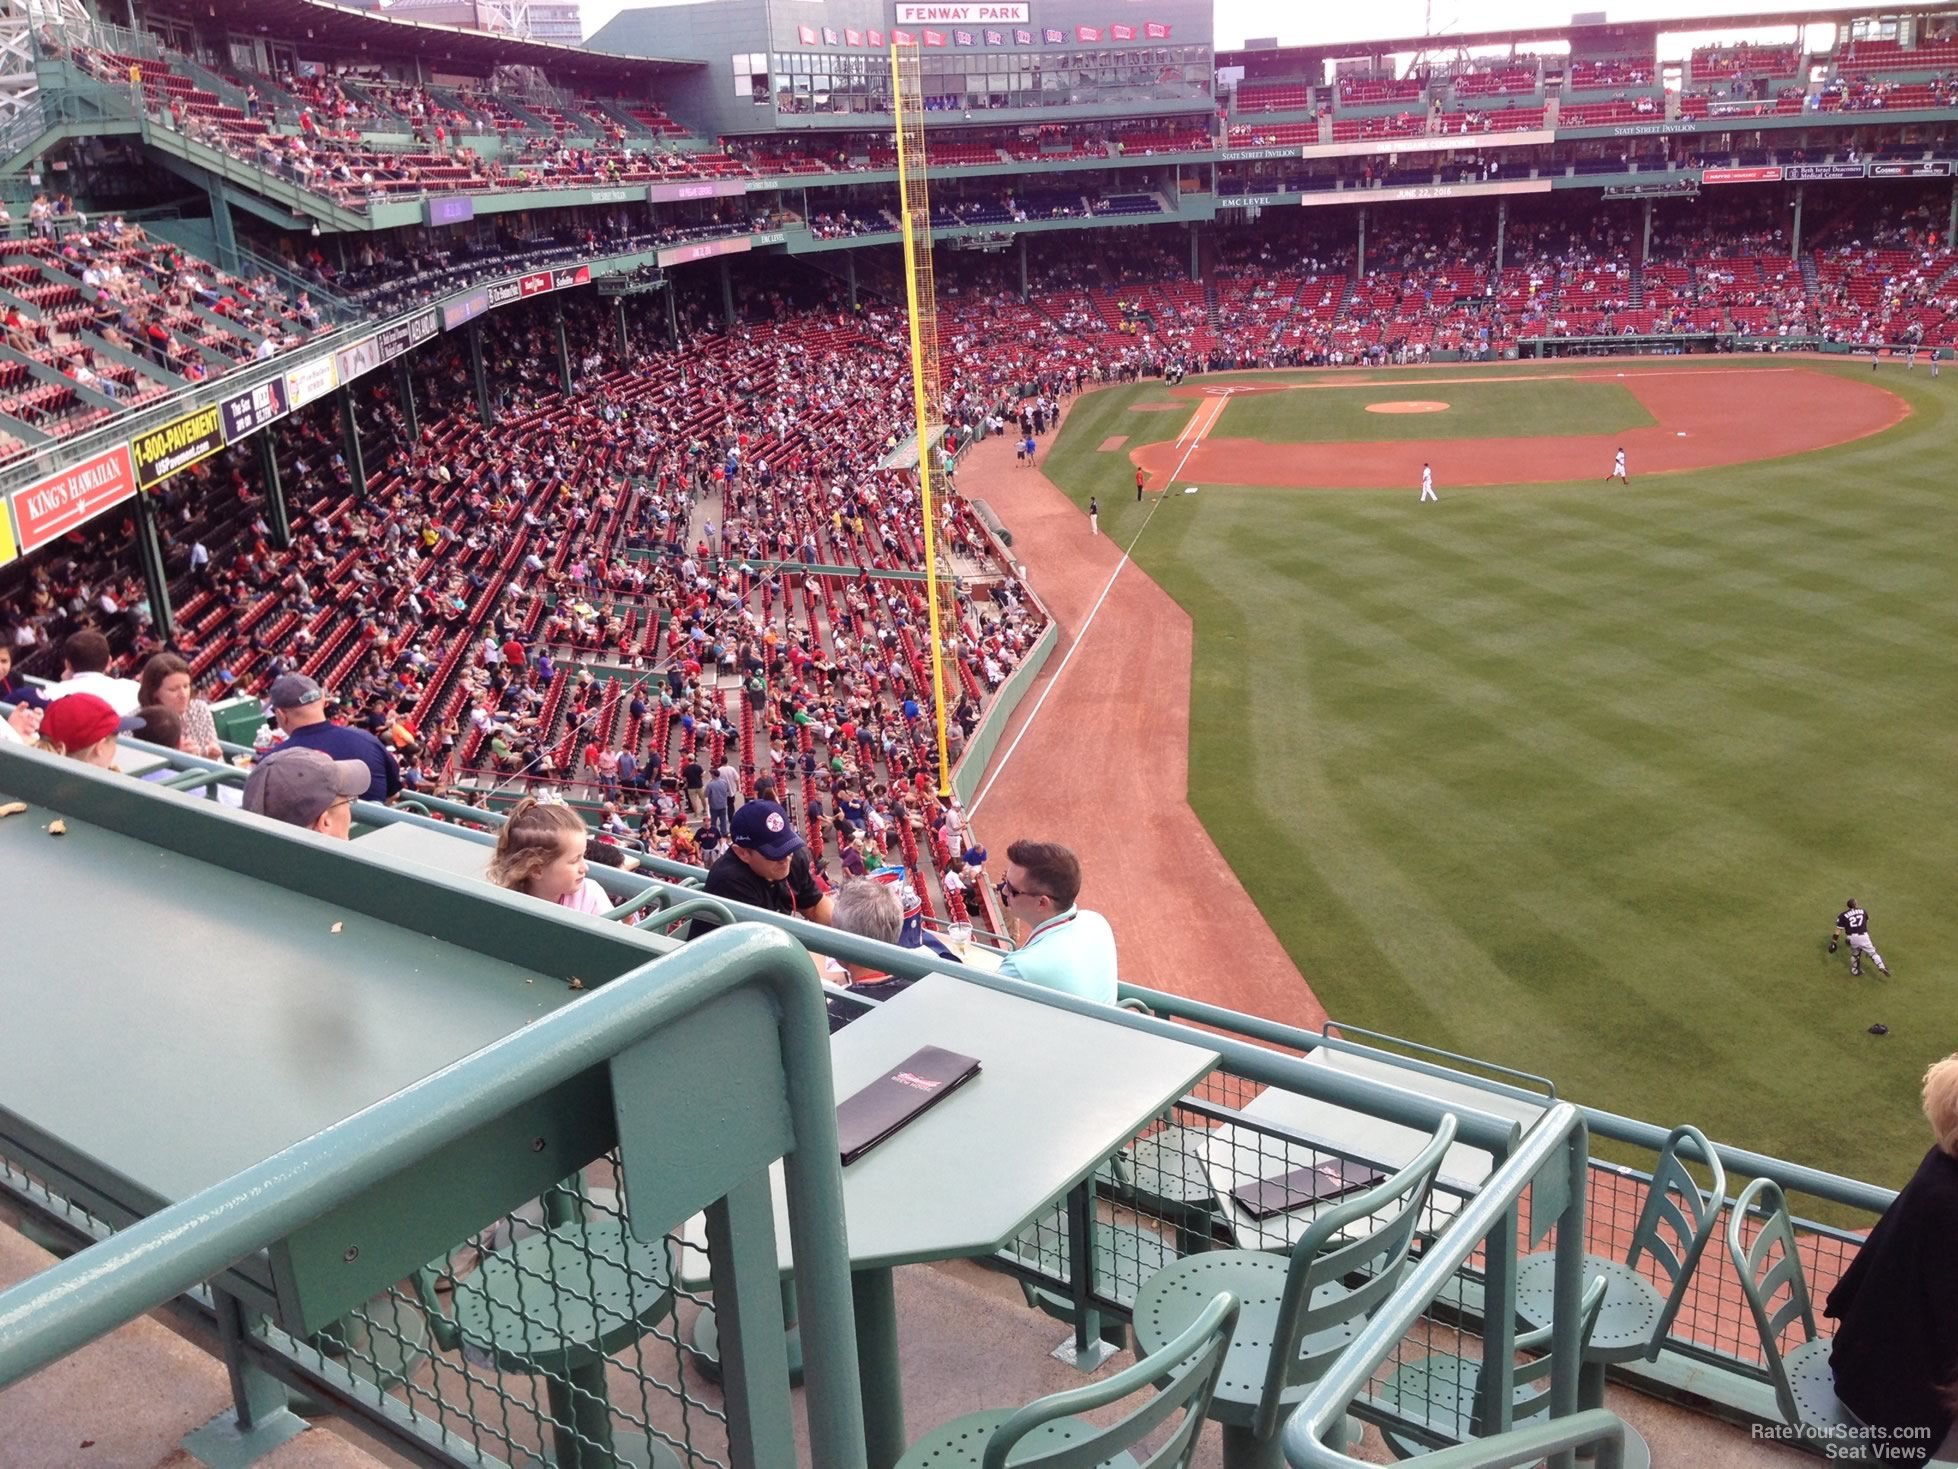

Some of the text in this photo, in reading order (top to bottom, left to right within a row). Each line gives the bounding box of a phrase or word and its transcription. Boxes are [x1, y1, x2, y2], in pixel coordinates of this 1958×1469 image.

[905, 8, 1020, 19] FENWAY PARK
[1614, 124, 1696, 136] STATE STREET PAVILION
[1222, 149, 1295, 160] STATE STREET PAVILION
[1397, 189, 1416, 198] JUNE
[1433, 187, 1452, 196] 2016
[1222, 197, 1271, 207] EMC LEVEL
[771, 234, 785, 243] LEVEL
[231, 399, 251, 417] The Sox
[244, 414, 252, 427] on
[135, 408, 219, 468] 1-800-PAVEMENT
[155, 440, 210, 476] USPavement.com
[27, 456, 122, 520] KING'S HAWAIIAN
[1848, 914, 1864, 928] 27
